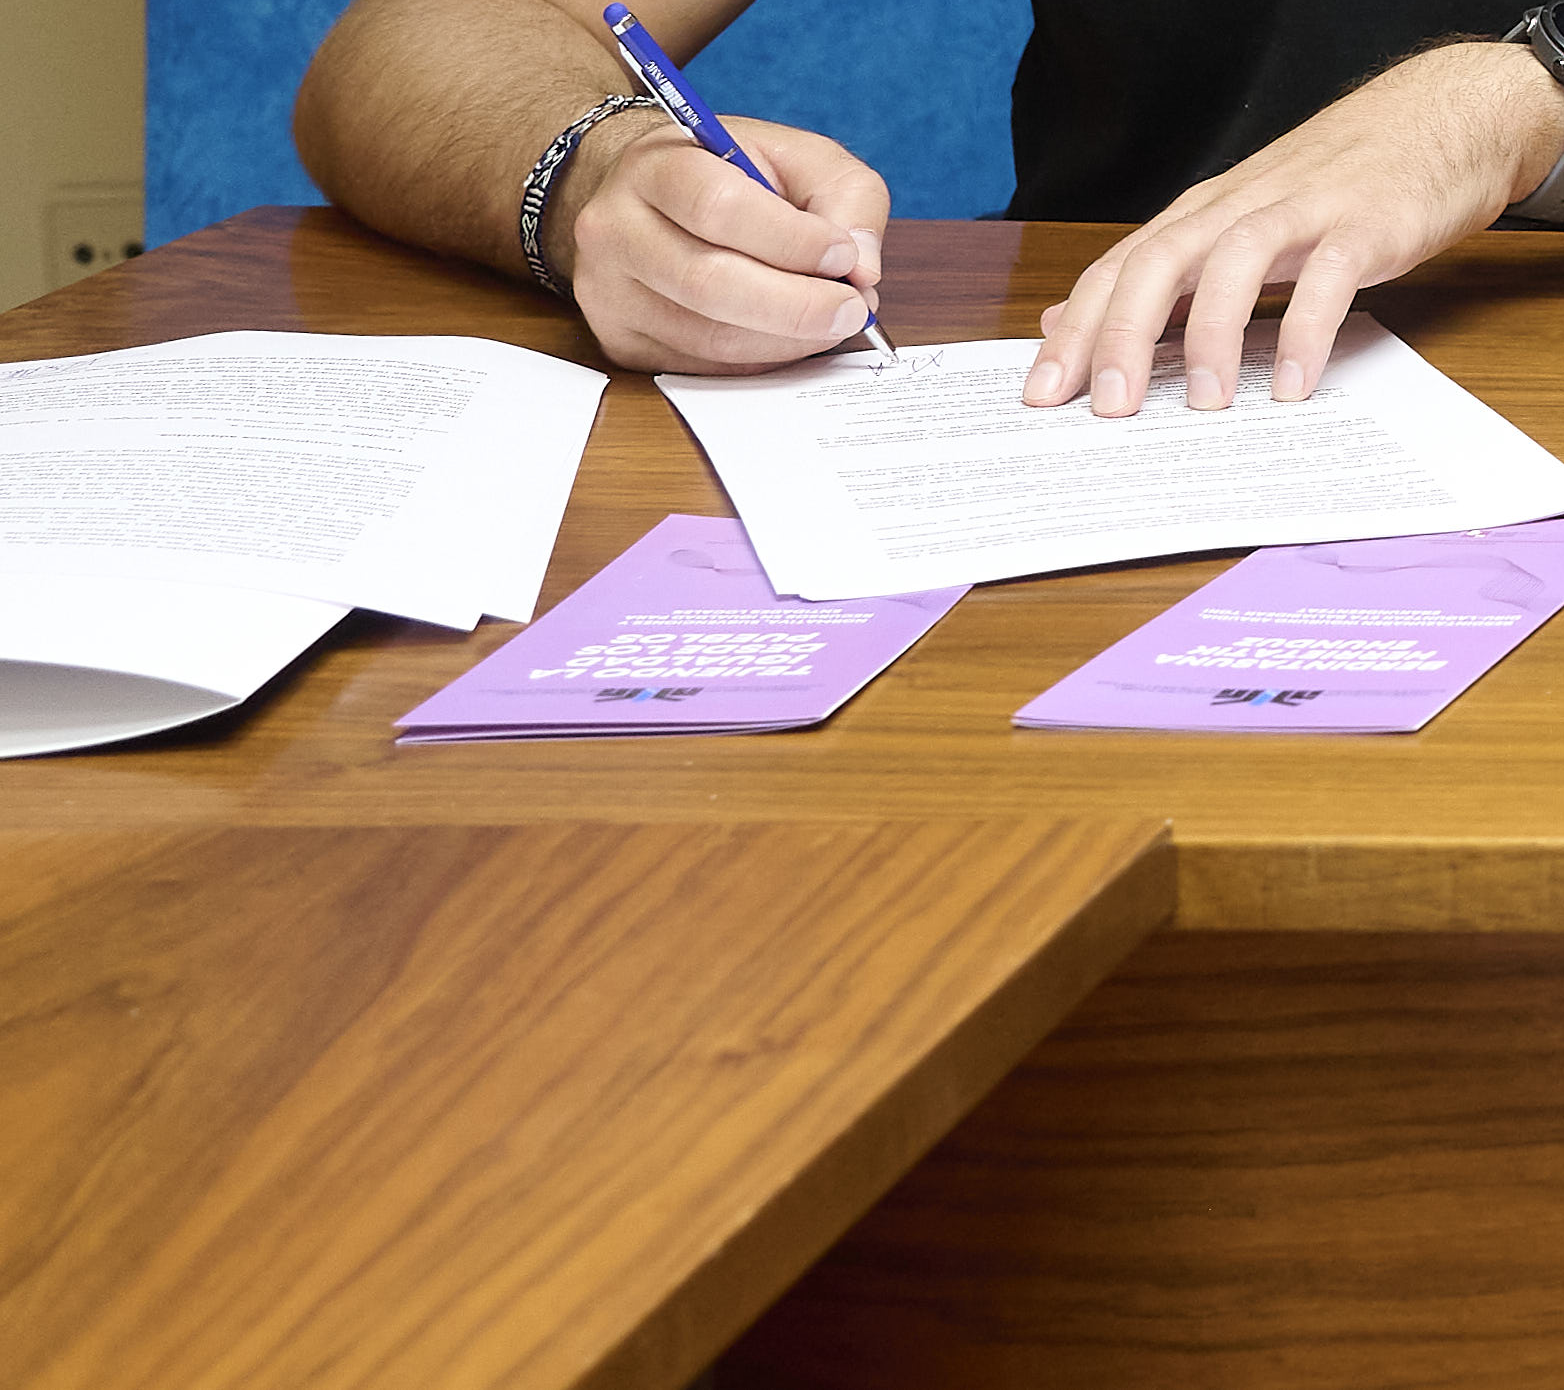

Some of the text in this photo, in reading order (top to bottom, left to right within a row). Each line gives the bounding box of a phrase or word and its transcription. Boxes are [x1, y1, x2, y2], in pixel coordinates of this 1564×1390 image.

[609, 631, 821, 644] PUEBLOS
[1231, 636, 1421, 651] EHUNDUZ
[574, 643, 828, 656] DESDE LOS
[1186, 645, 1439, 661] HERRIETATIK
[565, 654, 810, 668] IGUALDAD
[1155, 653, 1450, 672] BERDINTASUNA
[529, 665, 814, 680] TEJIENDO LA
